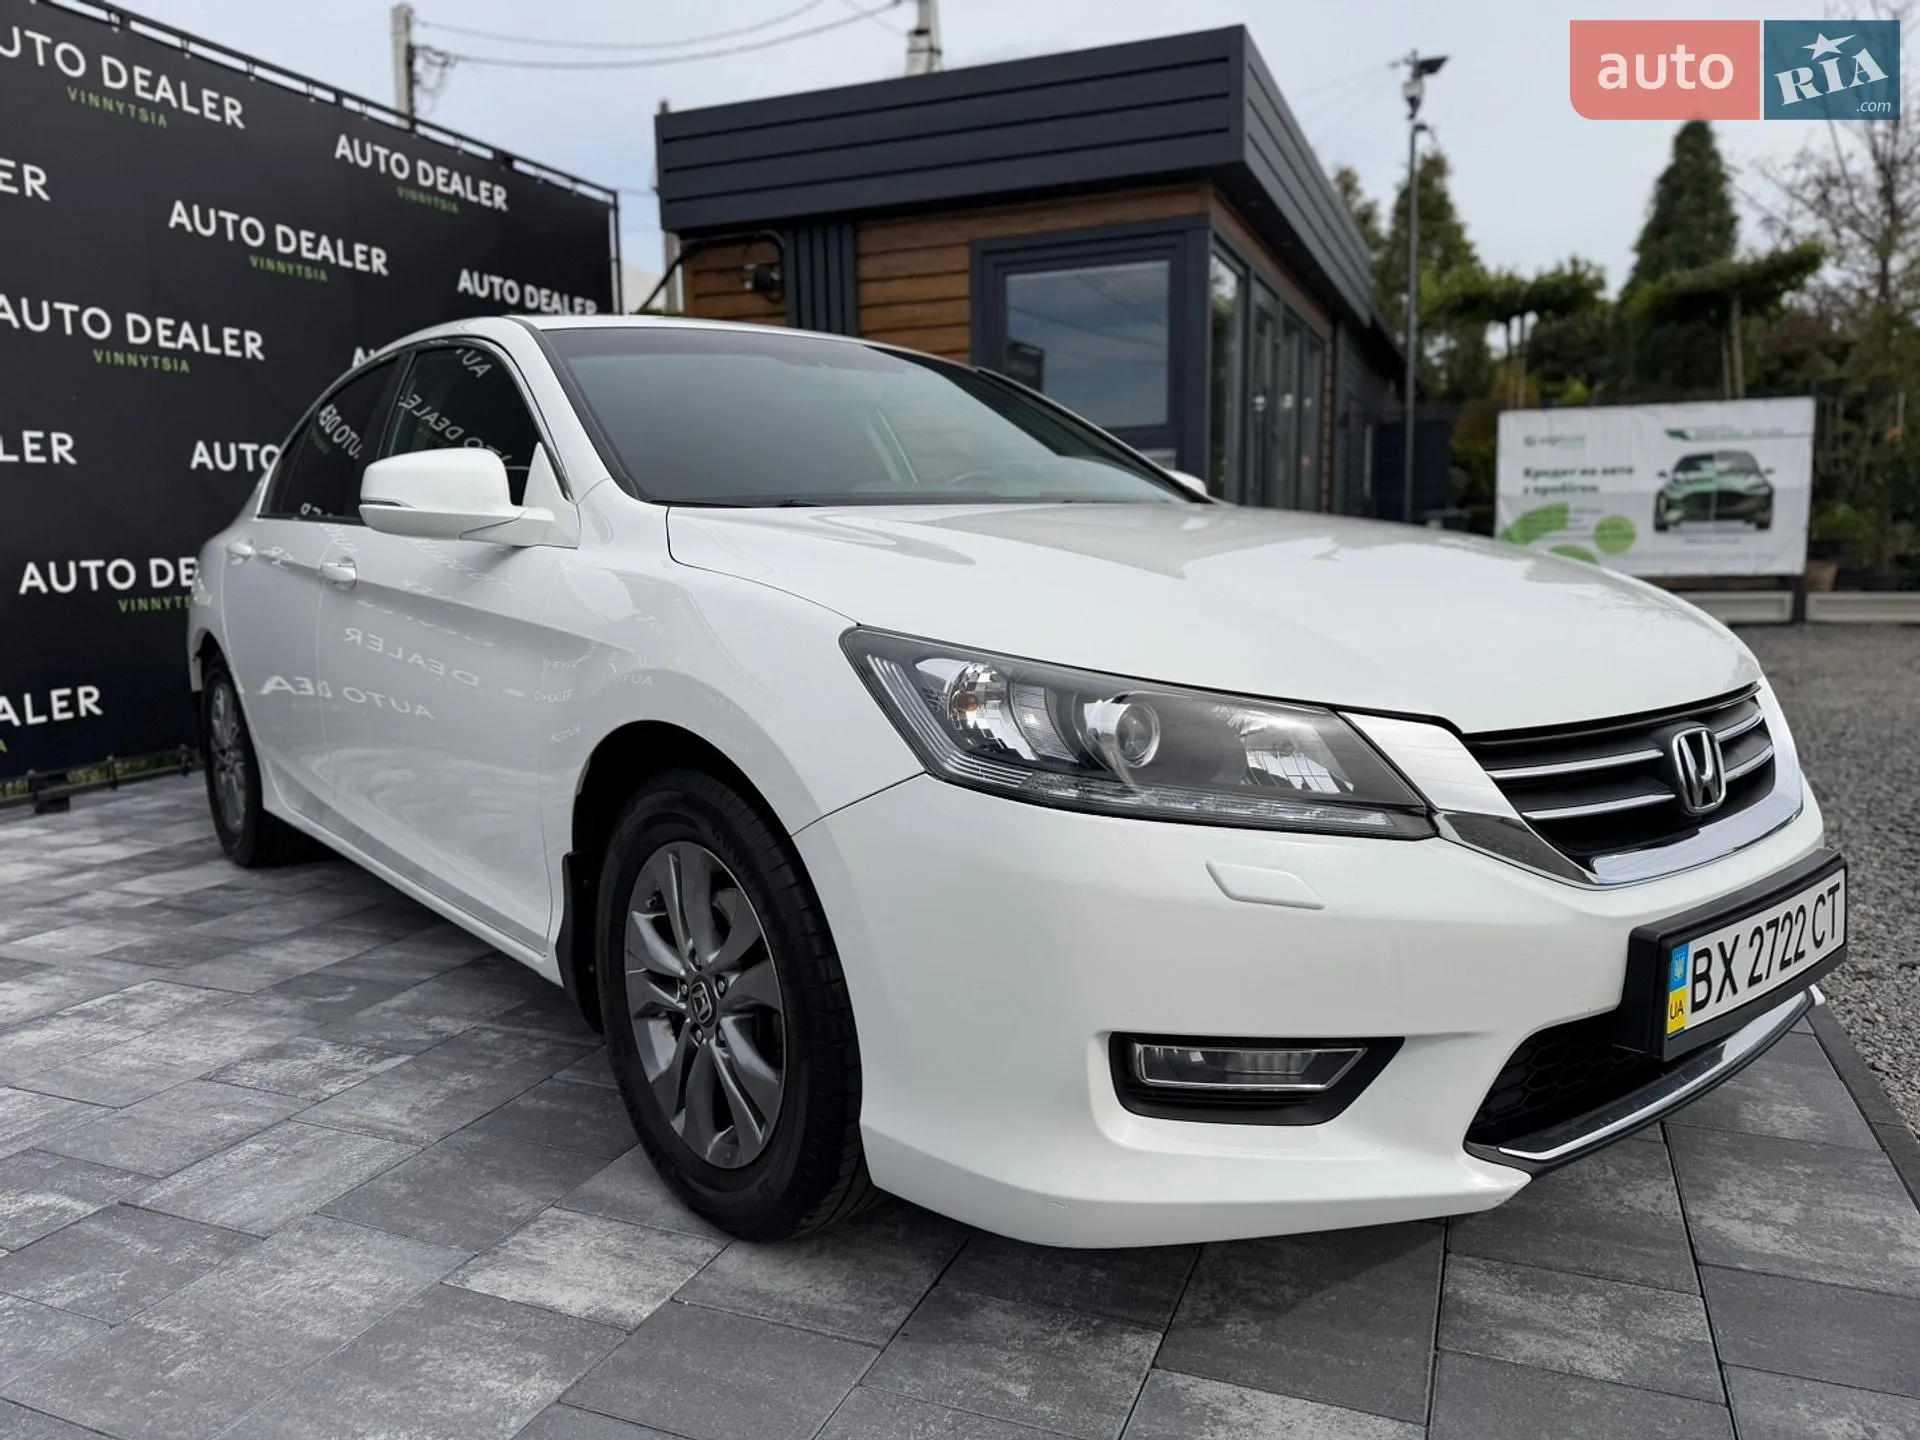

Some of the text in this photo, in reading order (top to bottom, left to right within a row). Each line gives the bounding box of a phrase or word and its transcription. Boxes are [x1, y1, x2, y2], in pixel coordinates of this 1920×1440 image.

[67, 86, 168, 128] VINNYTSIA
[101, 54, 246, 129] DEALER
[335, 134, 509, 212] AUTO DEALER
[169, 200, 389, 276] AUTO DEALER
[249, 254, 329, 283] VINNYTSIA
[457, 268, 521, 305] AUTO
[0, 293, 265, 361] AUTO DEALER
[93, 349, 190, 373] VINNYTSIA
[190, 440, 280, 472] AUTO
[19, 558, 137, 595] AUTO
[1691, 882, 1840, 1013] BX 2722 CT
[1669, 999, 1684, 1020] UA
